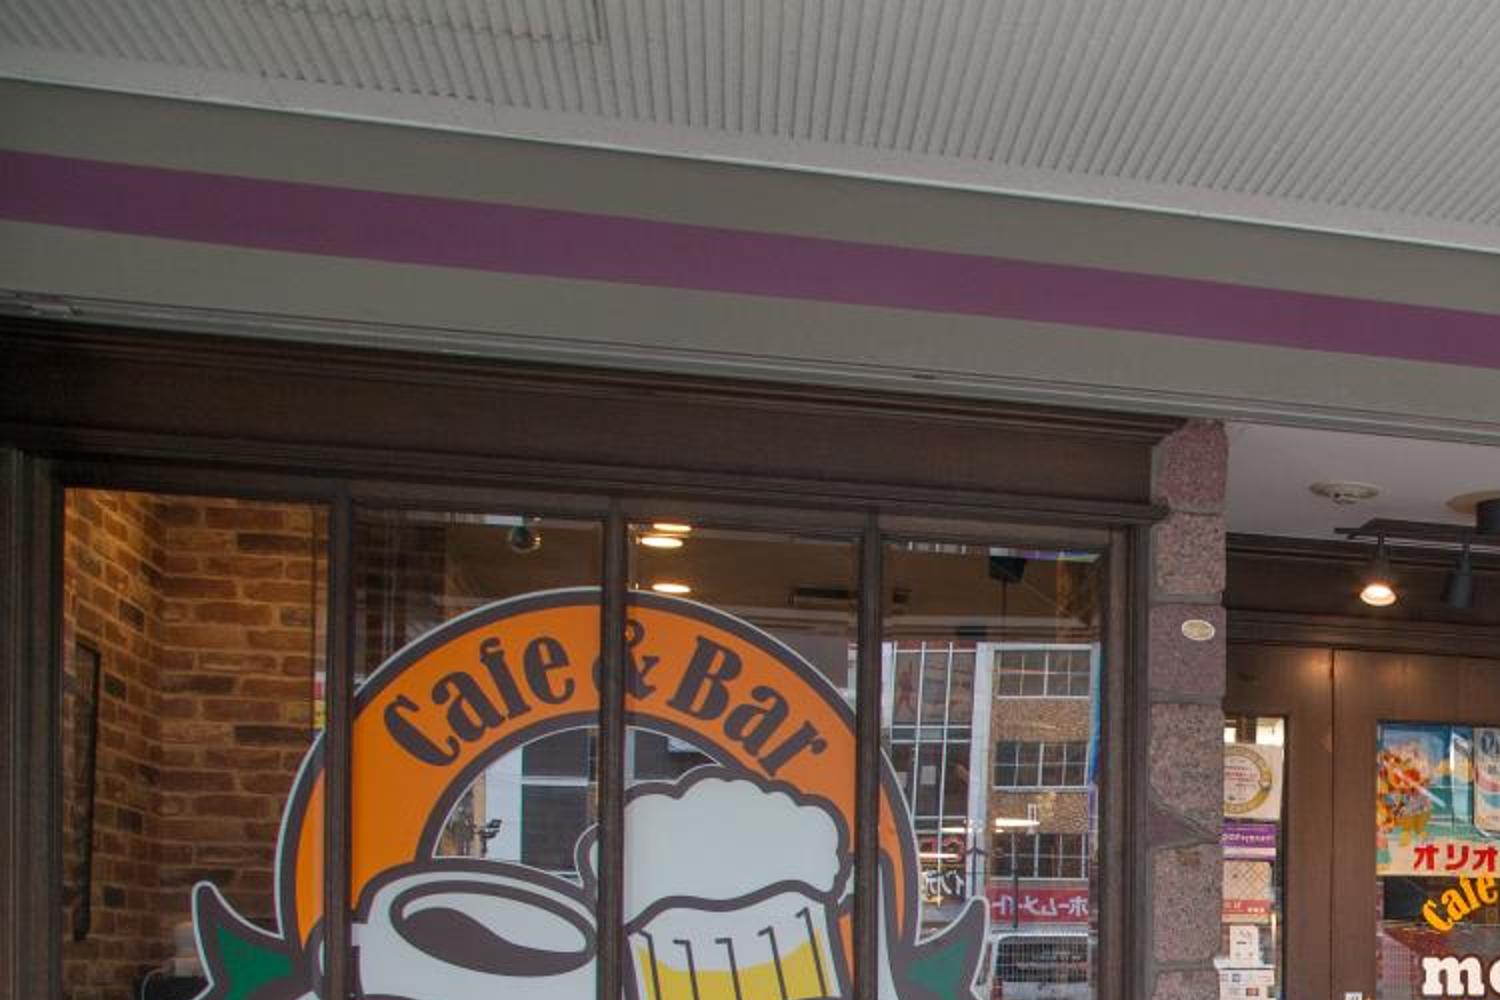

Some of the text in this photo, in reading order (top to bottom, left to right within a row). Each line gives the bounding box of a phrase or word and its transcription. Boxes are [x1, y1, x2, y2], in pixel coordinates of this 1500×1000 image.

[383, 634, 576, 768] Cafe
[666, 634, 829, 777] Bar
[1422, 872, 1498, 932] Cafe
